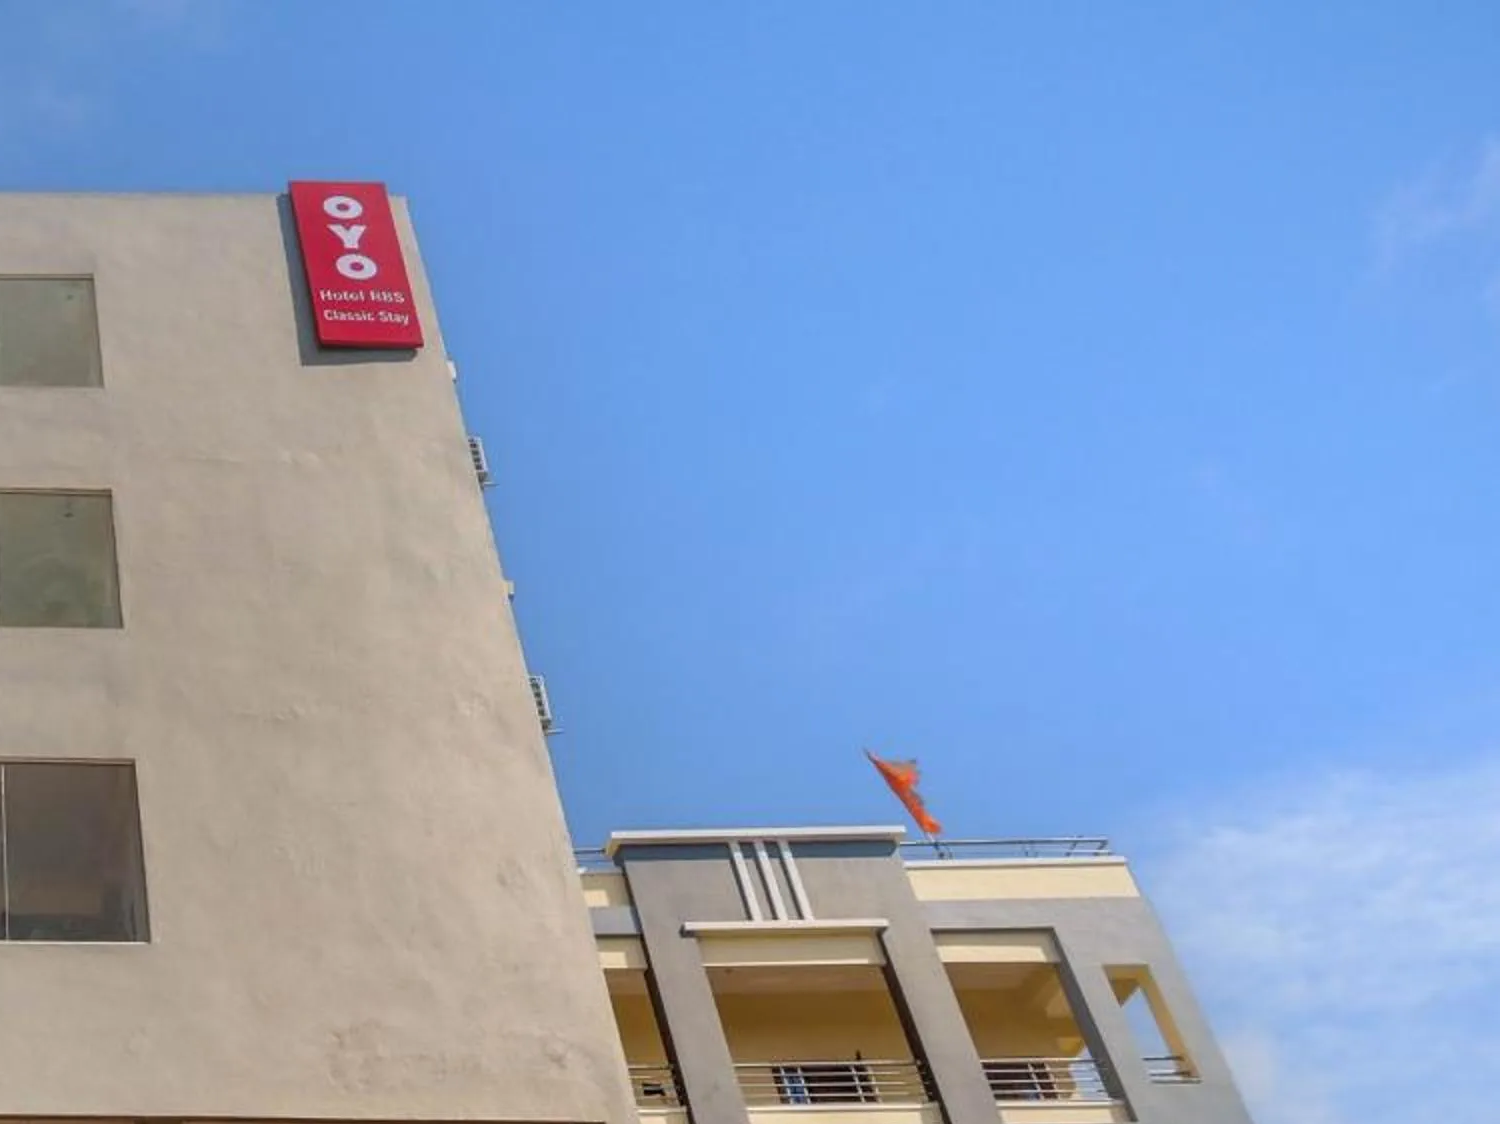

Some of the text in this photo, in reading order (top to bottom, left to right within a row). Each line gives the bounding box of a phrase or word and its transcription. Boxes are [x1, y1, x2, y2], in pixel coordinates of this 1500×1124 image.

[323, 195, 378, 281] OYO
[320, 289, 365, 302] Hotel
[323, 309, 409, 326] Classic Stay
